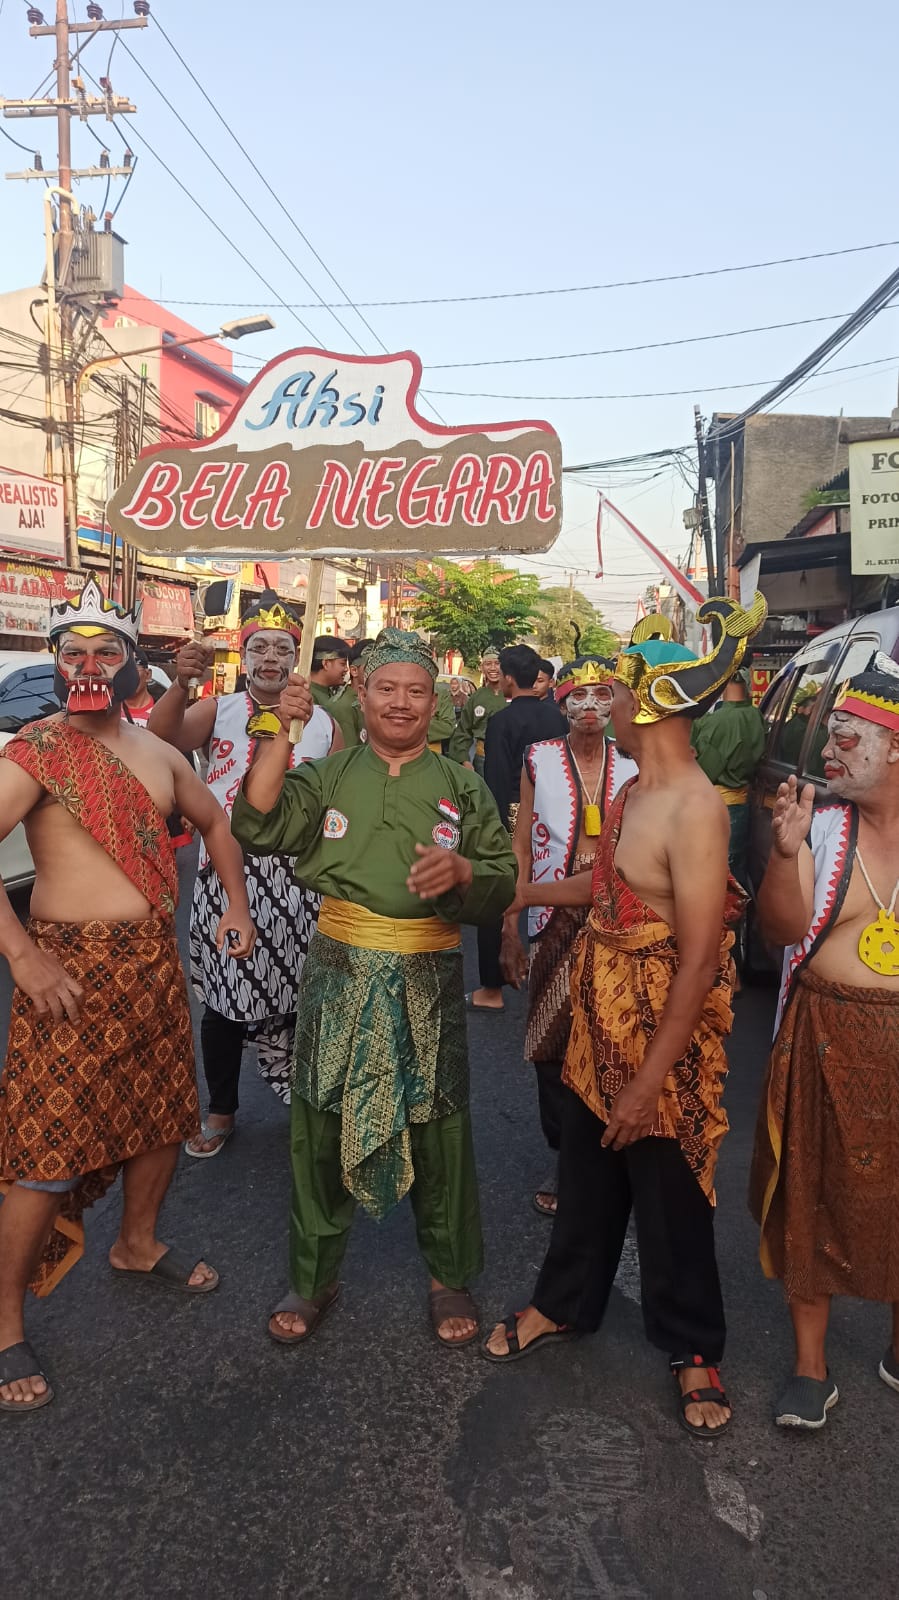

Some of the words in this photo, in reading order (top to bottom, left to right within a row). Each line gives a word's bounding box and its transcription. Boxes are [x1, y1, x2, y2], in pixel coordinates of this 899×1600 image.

[244, 368, 385, 432] Aksi
[19, 508, 45, 528] AJA!
[120, 459, 292, 532] BELA
[306, 450, 557, 530] NEGARA
